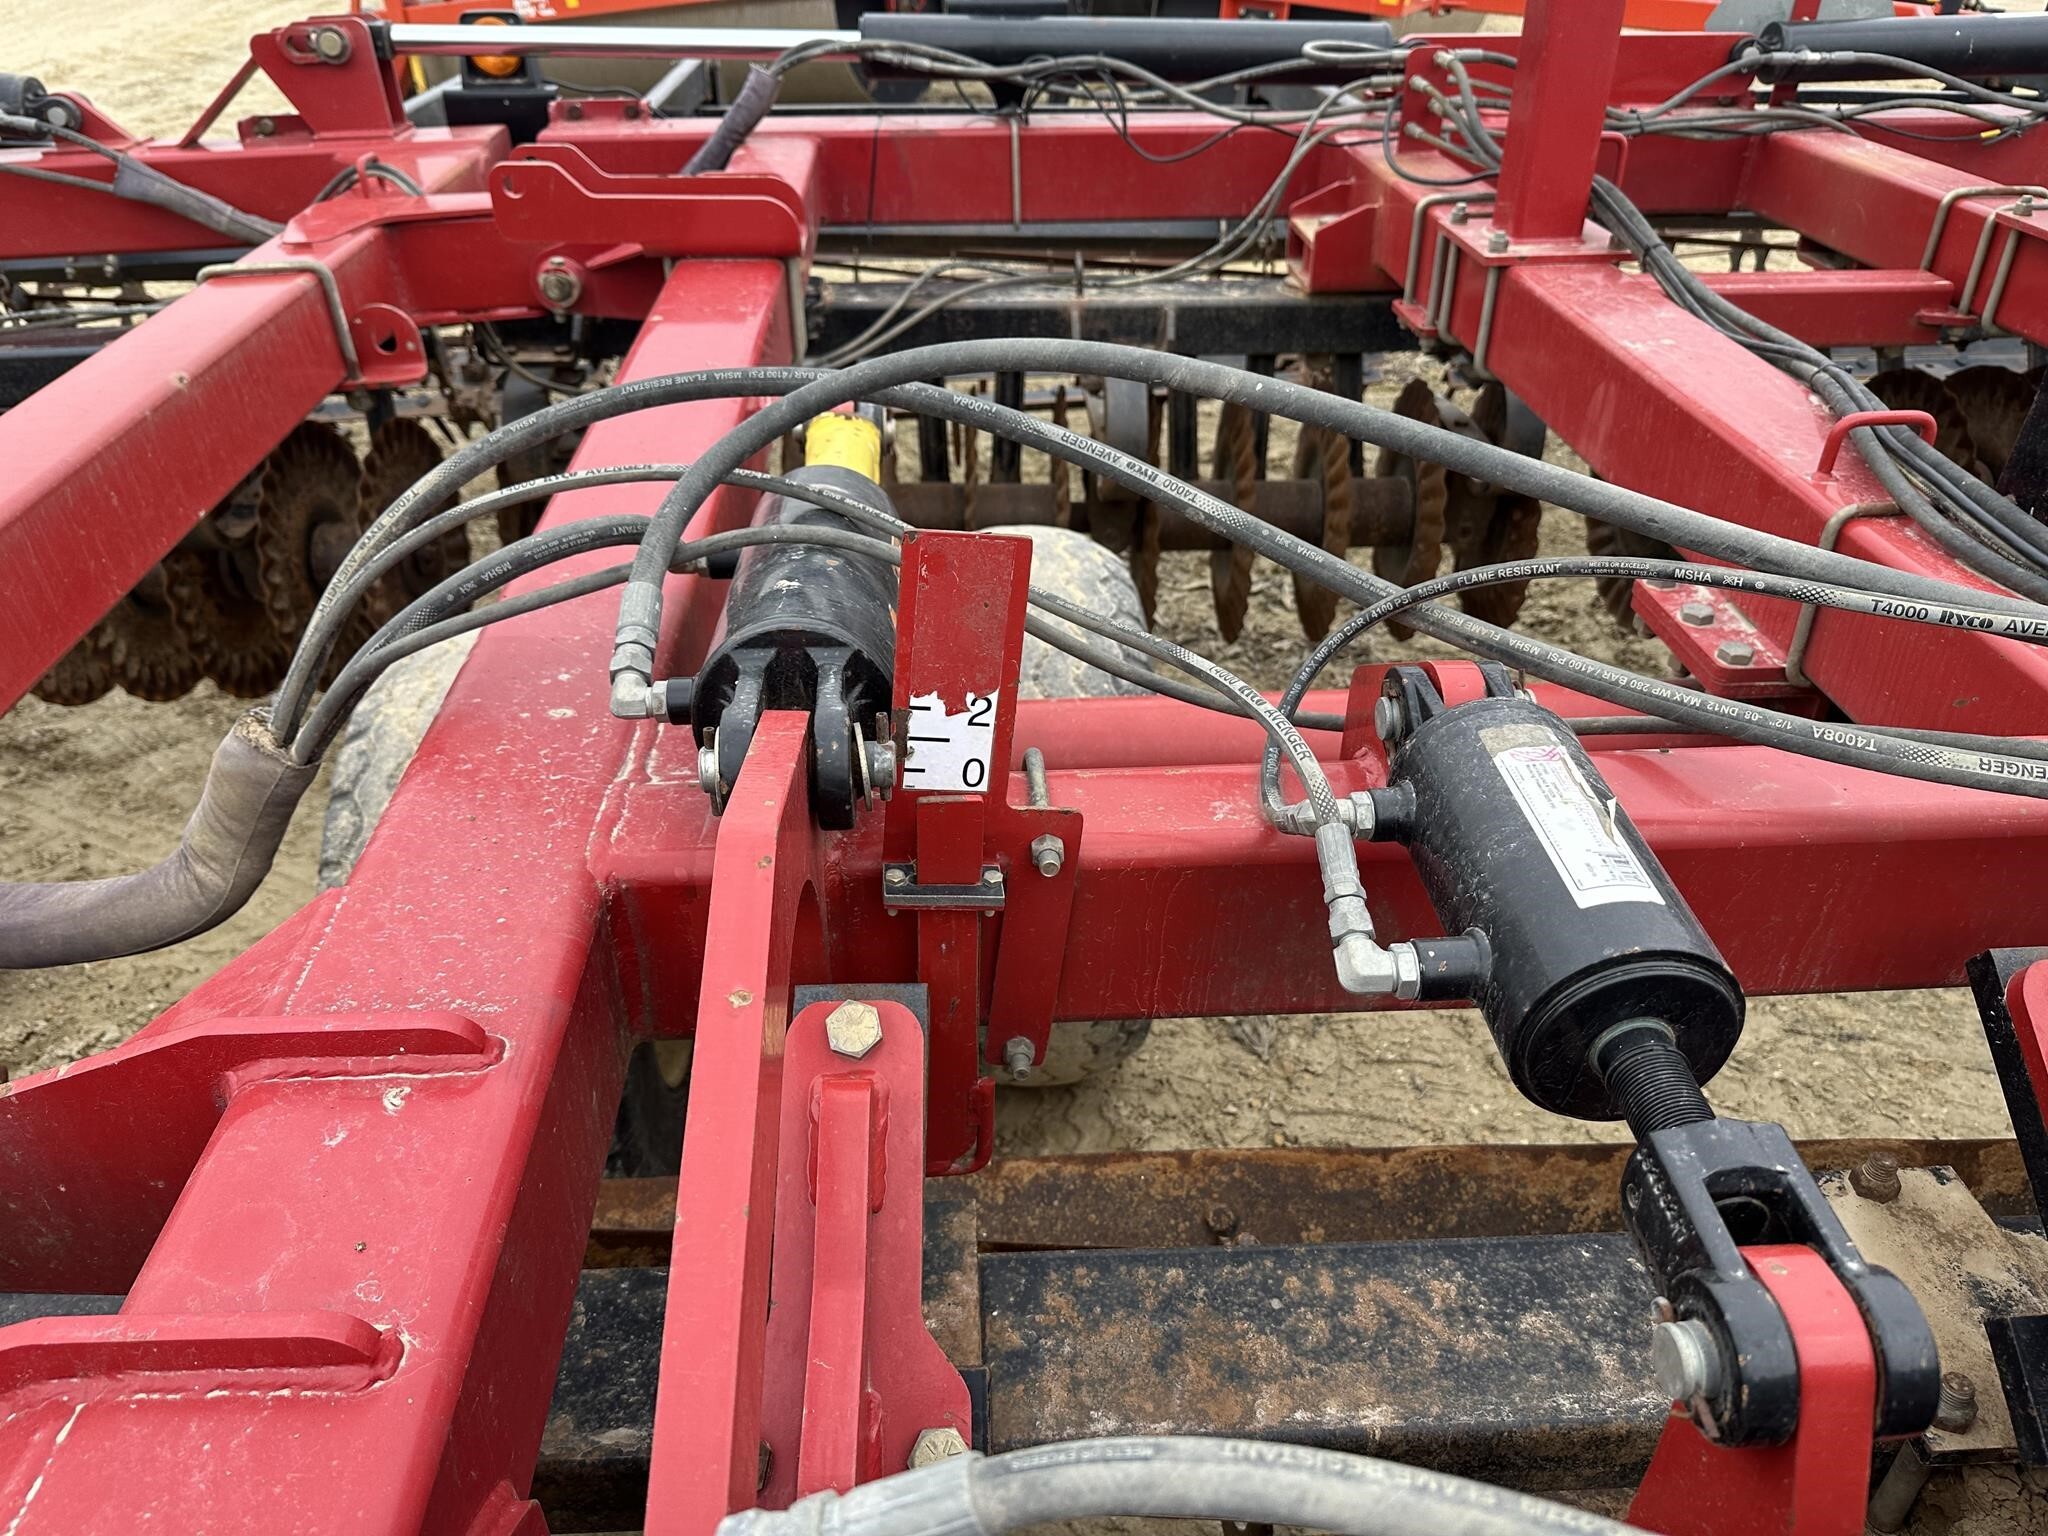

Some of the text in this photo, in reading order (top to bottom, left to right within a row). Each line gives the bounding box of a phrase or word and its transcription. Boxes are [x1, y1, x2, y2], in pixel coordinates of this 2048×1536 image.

[673, 373, 707, 384] FLAME
[713, 370, 741, 380] MSHA
[621, 376, 672, 394] RESISTANT
[508, 415, 536, 432] MSHA
[1059, 430, 1122, 465] AVENGER
[1161, 476, 1199, 503] T4000
[1295, 543, 1325, 564] MSHA
[480, 561, 512, 582] MSHA
[1675, 569, 1712, 582] MSHA
[317, 553, 357, 613] AVENGER
[1411, 595, 1465, 626] RESISTA
[1871, 599, 2048, 636] T4000 RYCO AVE
[1300, 661, 1317, 680] MAX
[1329, 633, 1344, 649] 280
[1371, 602, 1393, 618] 4100
[1395, 594, 1412, 607] PSI
[1418, 581, 1450, 598] MSHA
[1458, 570, 1495, 586] FLAME
[1498, 563, 1561, 578] RESISTANT
[1463, 619, 1501, 641] FLAME
[1507, 636, 1541, 655] MSHA
[1546, 650, 1567, 664] PSI
[1567, 657, 1594, 674] 4100
[1600, 669, 1628, 685] BAR
[1628, 678, 1650, 692] 280
[1650, 684, 1672, 698] WP
[1673, 690, 1701, 706] MAX
[967, 697, 993, 727] 2
[1706, 699, 1738, 716] DN12
[1742, 709, 1763, 723] -08
[1768, 715, 1793, 730] 1/2"
[1263, 707, 1312, 762] AVENGER
[1810, 725, 1877, 751] T4008A
[962, 758, 985, 787] 0
